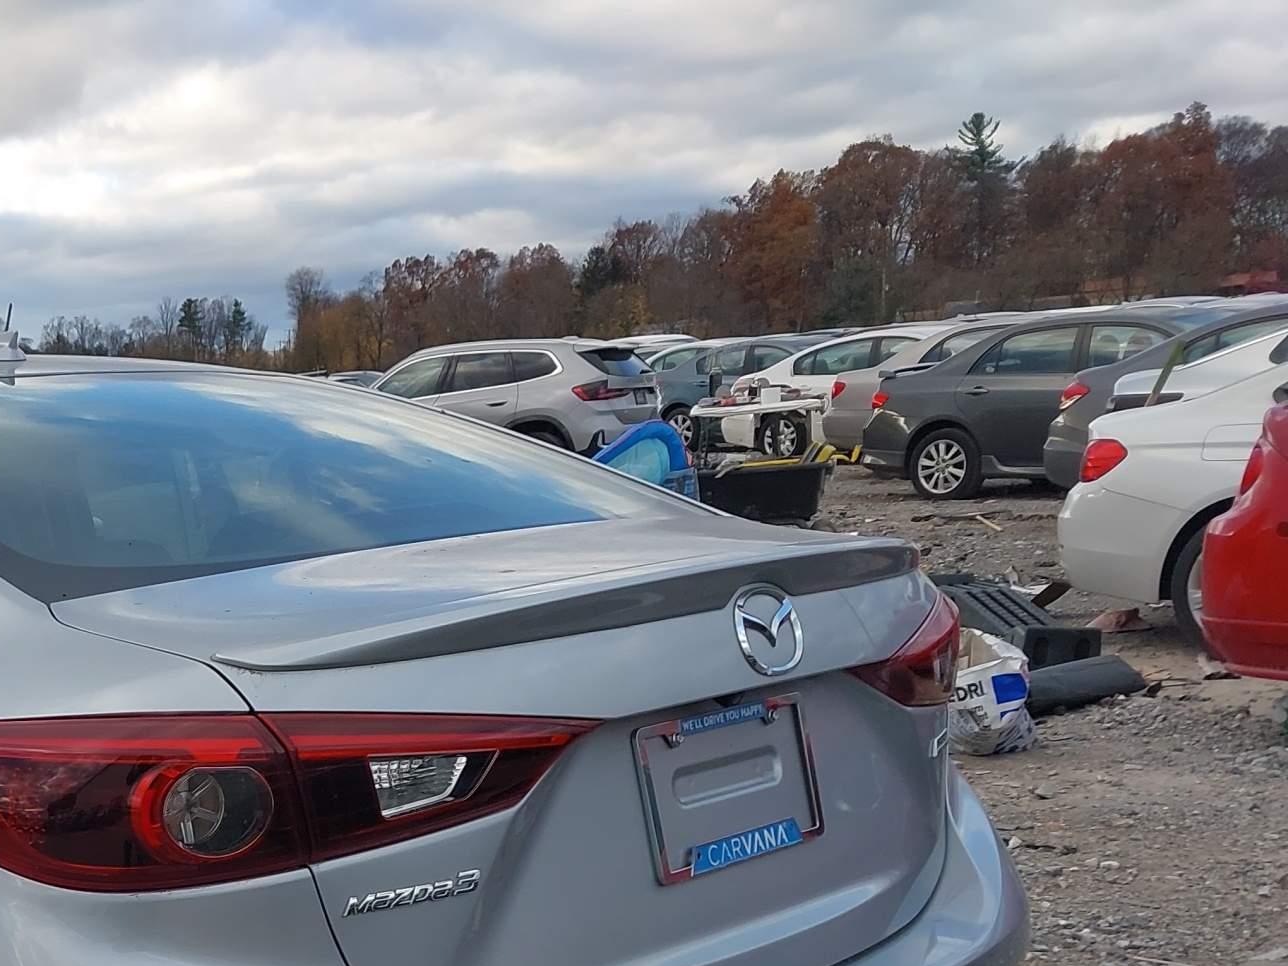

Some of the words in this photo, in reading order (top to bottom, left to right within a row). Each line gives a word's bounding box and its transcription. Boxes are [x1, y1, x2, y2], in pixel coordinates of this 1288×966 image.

[703, 713, 724, 727] DRIVE
[725, 710, 740, 721] YOU
[741, 703, 762, 717] HAPPY
[707, 823, 789, 866] CARVANA
